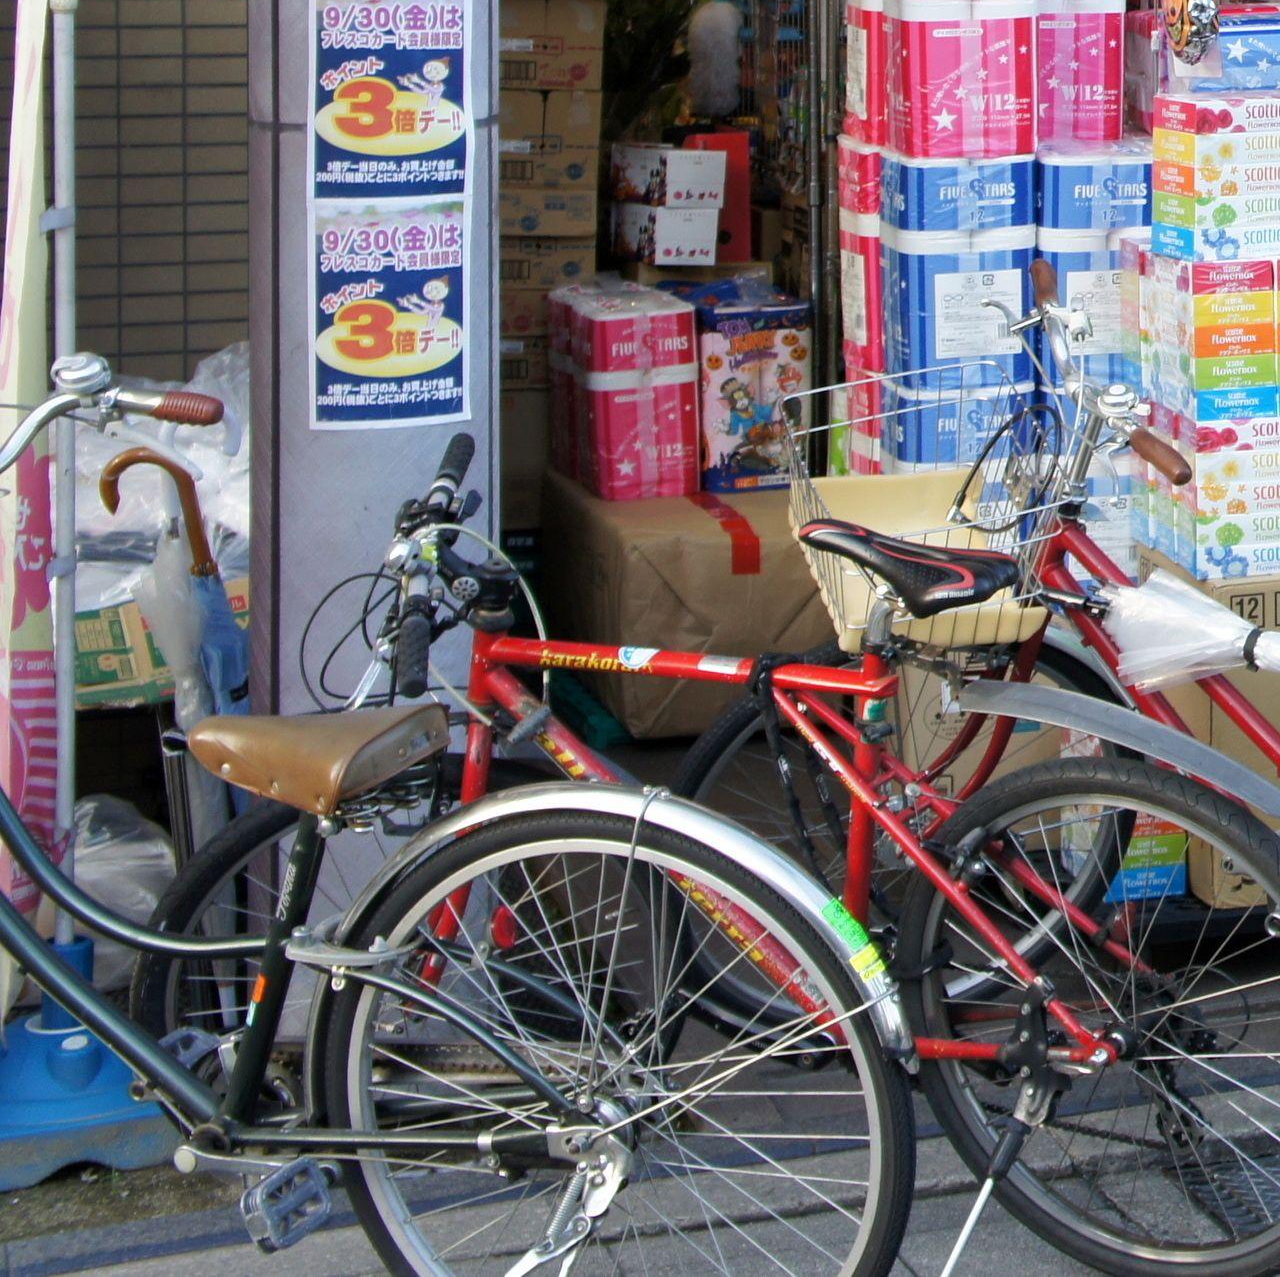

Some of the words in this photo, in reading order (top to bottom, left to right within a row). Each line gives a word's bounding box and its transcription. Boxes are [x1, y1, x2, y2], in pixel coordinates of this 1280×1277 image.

[322, 4, 463, 31] 9/30(金)は
[320, 56, 384, 91] ポイント
[322, 224, 461, 253] 9/30(金)は
[320, 278, 384, 313] ポイント
[1235, 597, 1259, 619] 12
